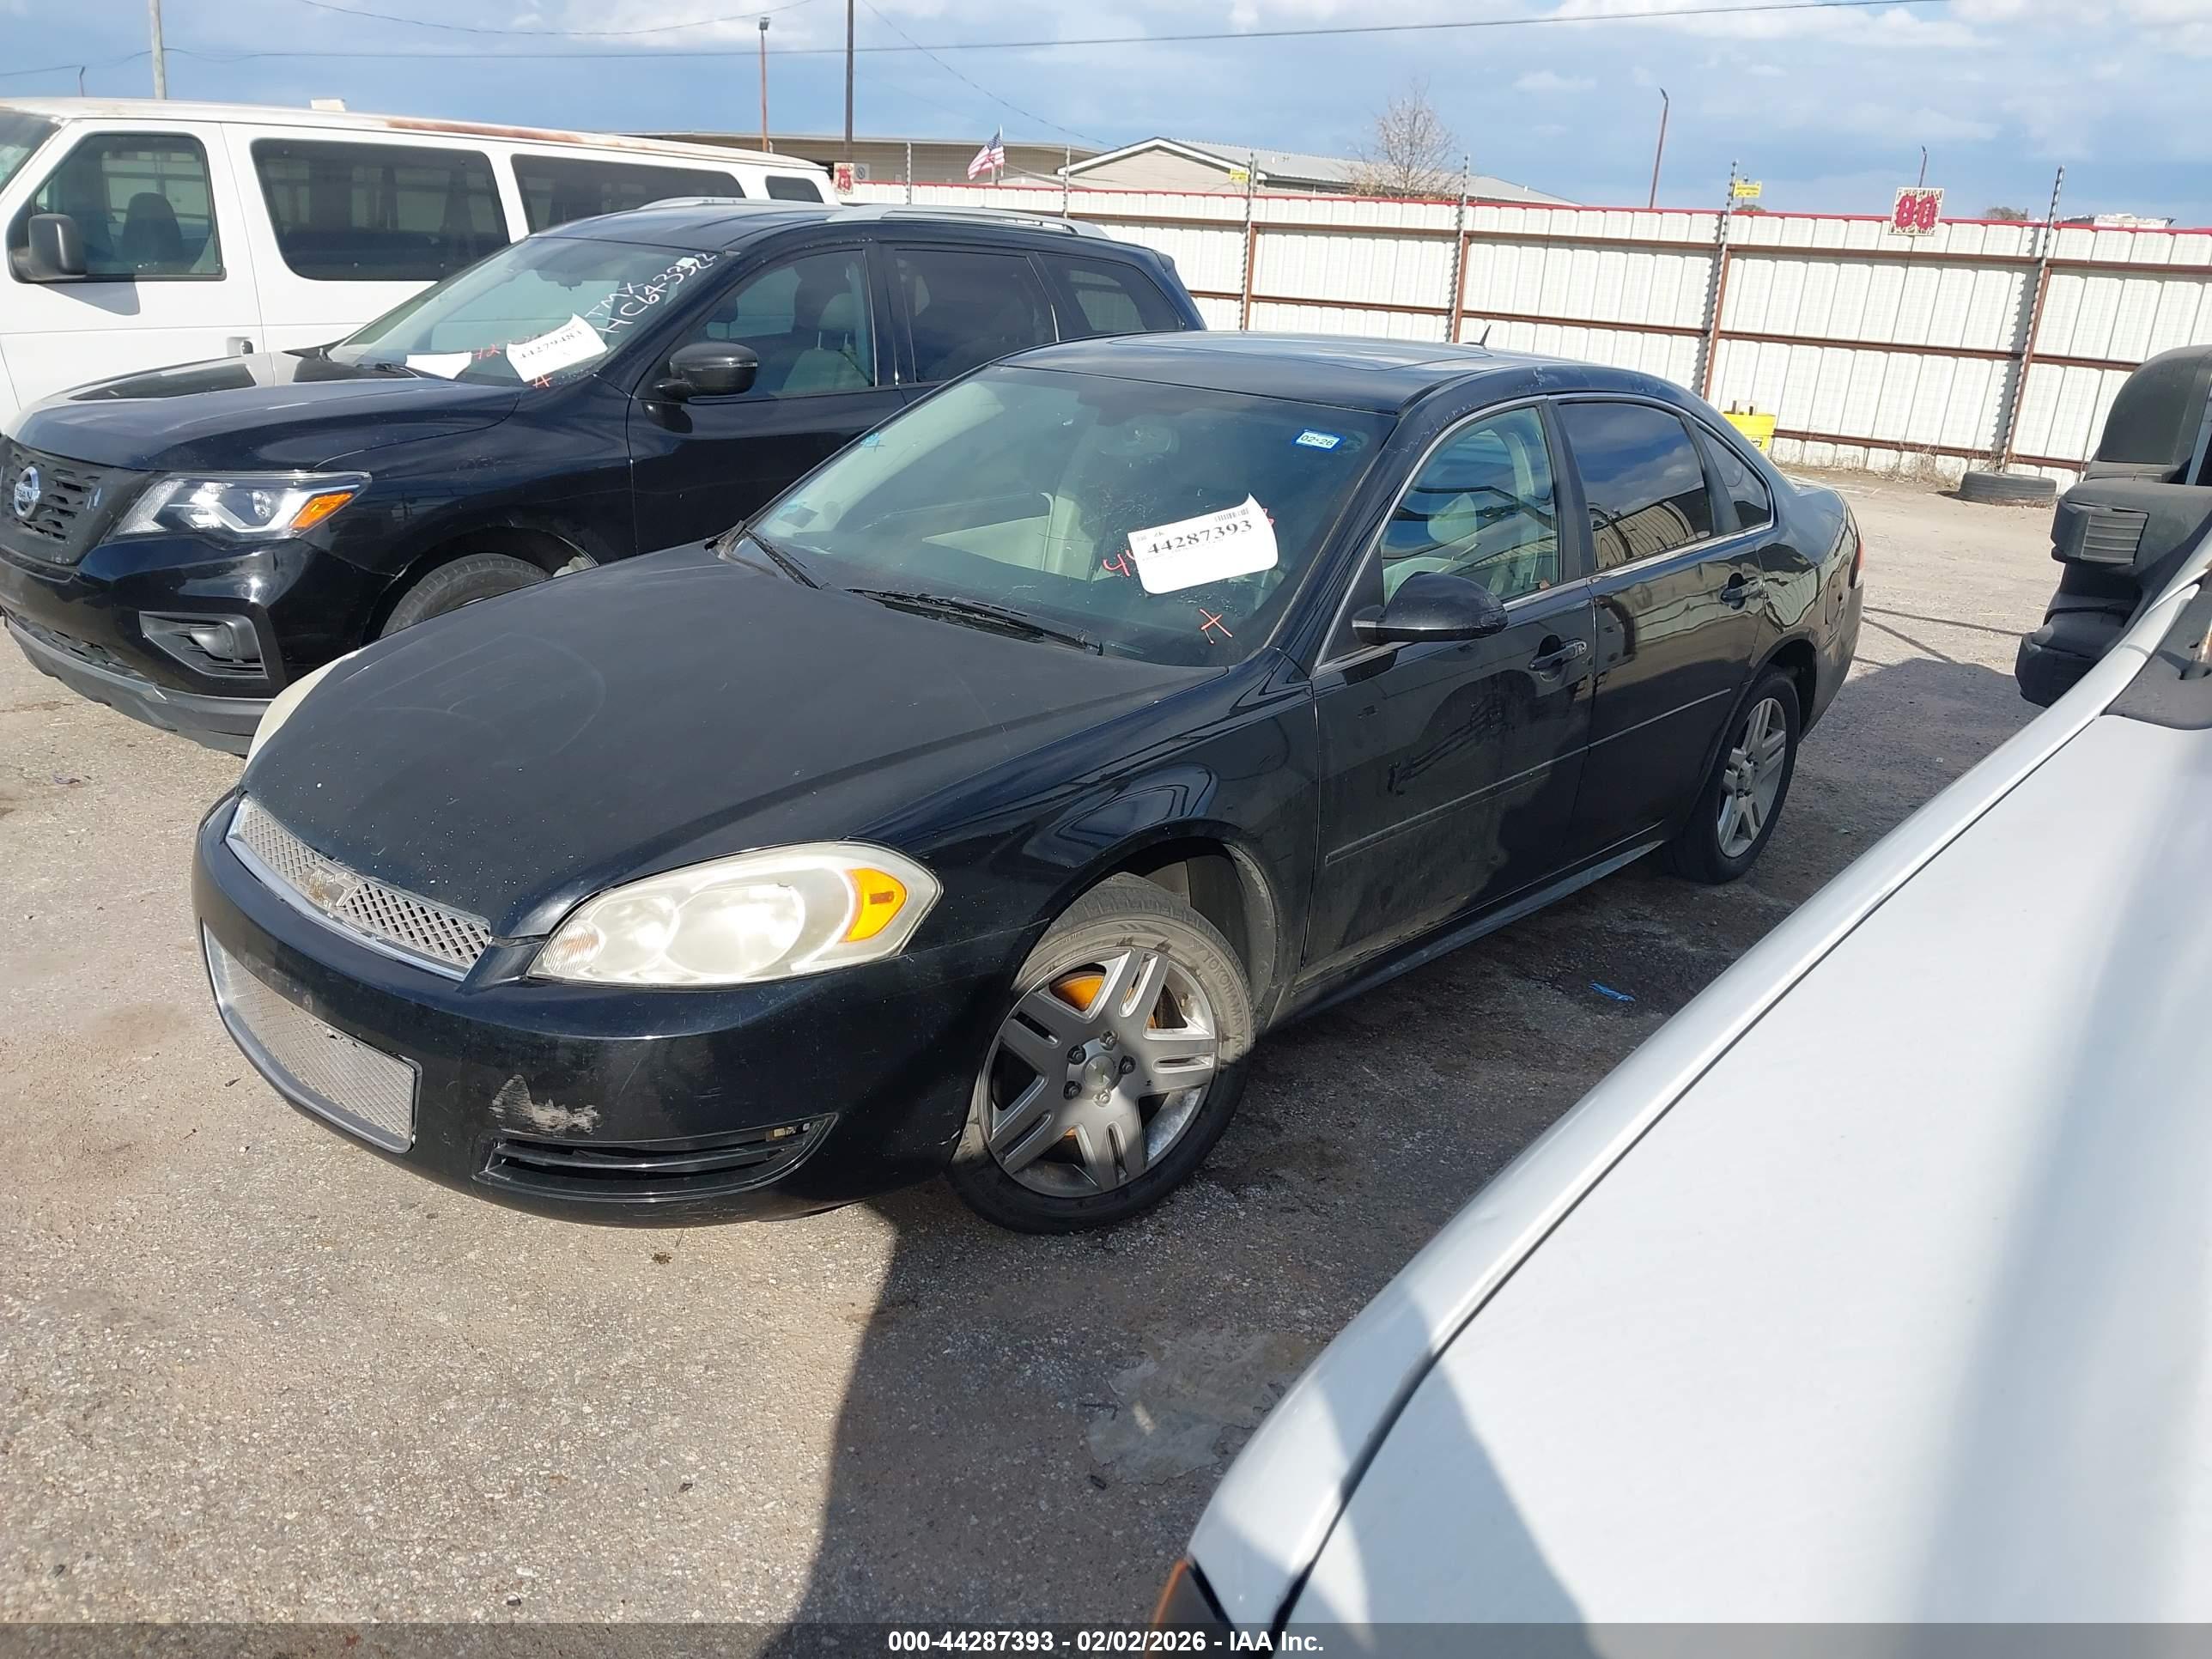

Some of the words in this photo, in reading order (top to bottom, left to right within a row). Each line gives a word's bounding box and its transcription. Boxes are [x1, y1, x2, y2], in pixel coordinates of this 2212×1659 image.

[1895, 195, 1937, 231] 80
[1147, 520, 1252, 554] 44287393
[1202, 951, 1245, 1027] YOKOHAMA
